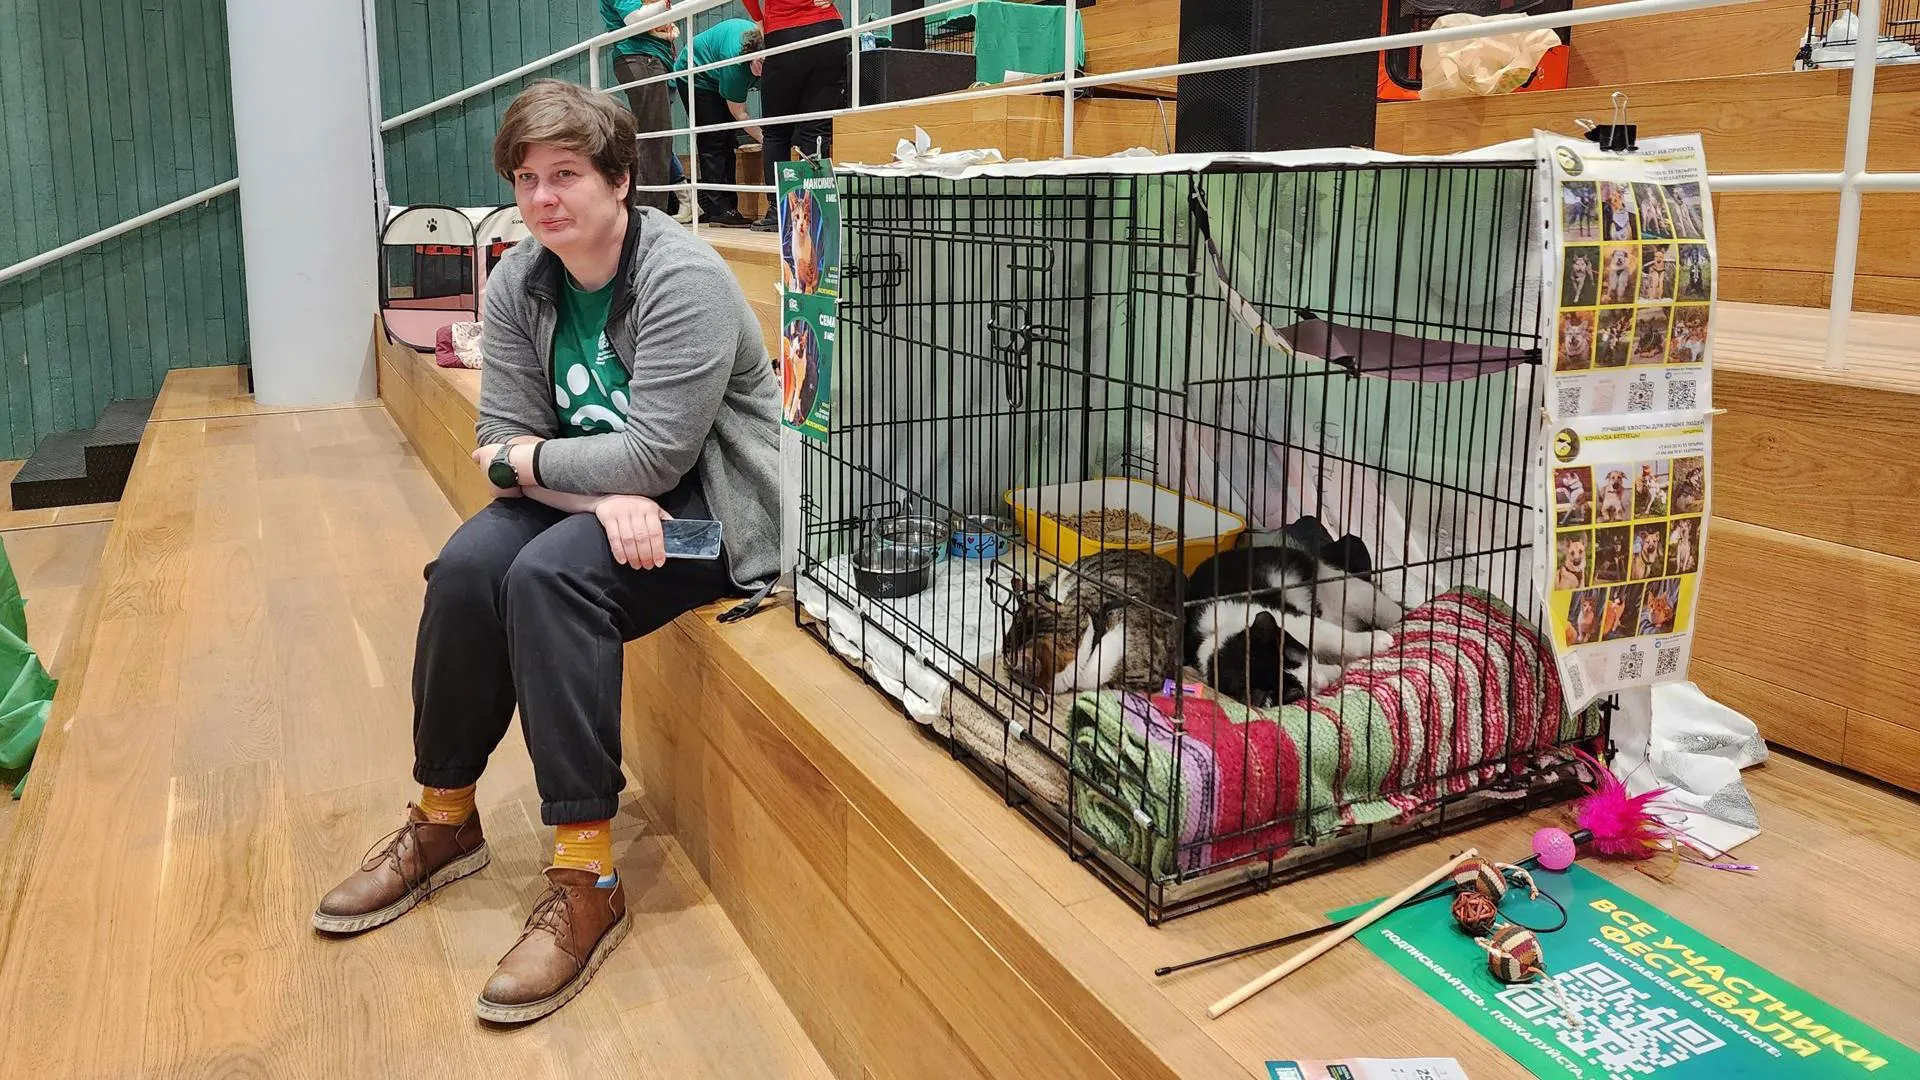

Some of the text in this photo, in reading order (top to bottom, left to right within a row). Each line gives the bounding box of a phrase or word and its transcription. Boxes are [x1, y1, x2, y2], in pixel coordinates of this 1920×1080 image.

[1588, 899, 1889, 1072] ВСЕ УЧАСТНИКИ
[1588, 937, 1782, 1058] ПРЕДСТАВЛЕНЫ В КАТАЛОГЕ:
[1599, 925, 1823, 1058] ФЕСТИВАЛЯ
